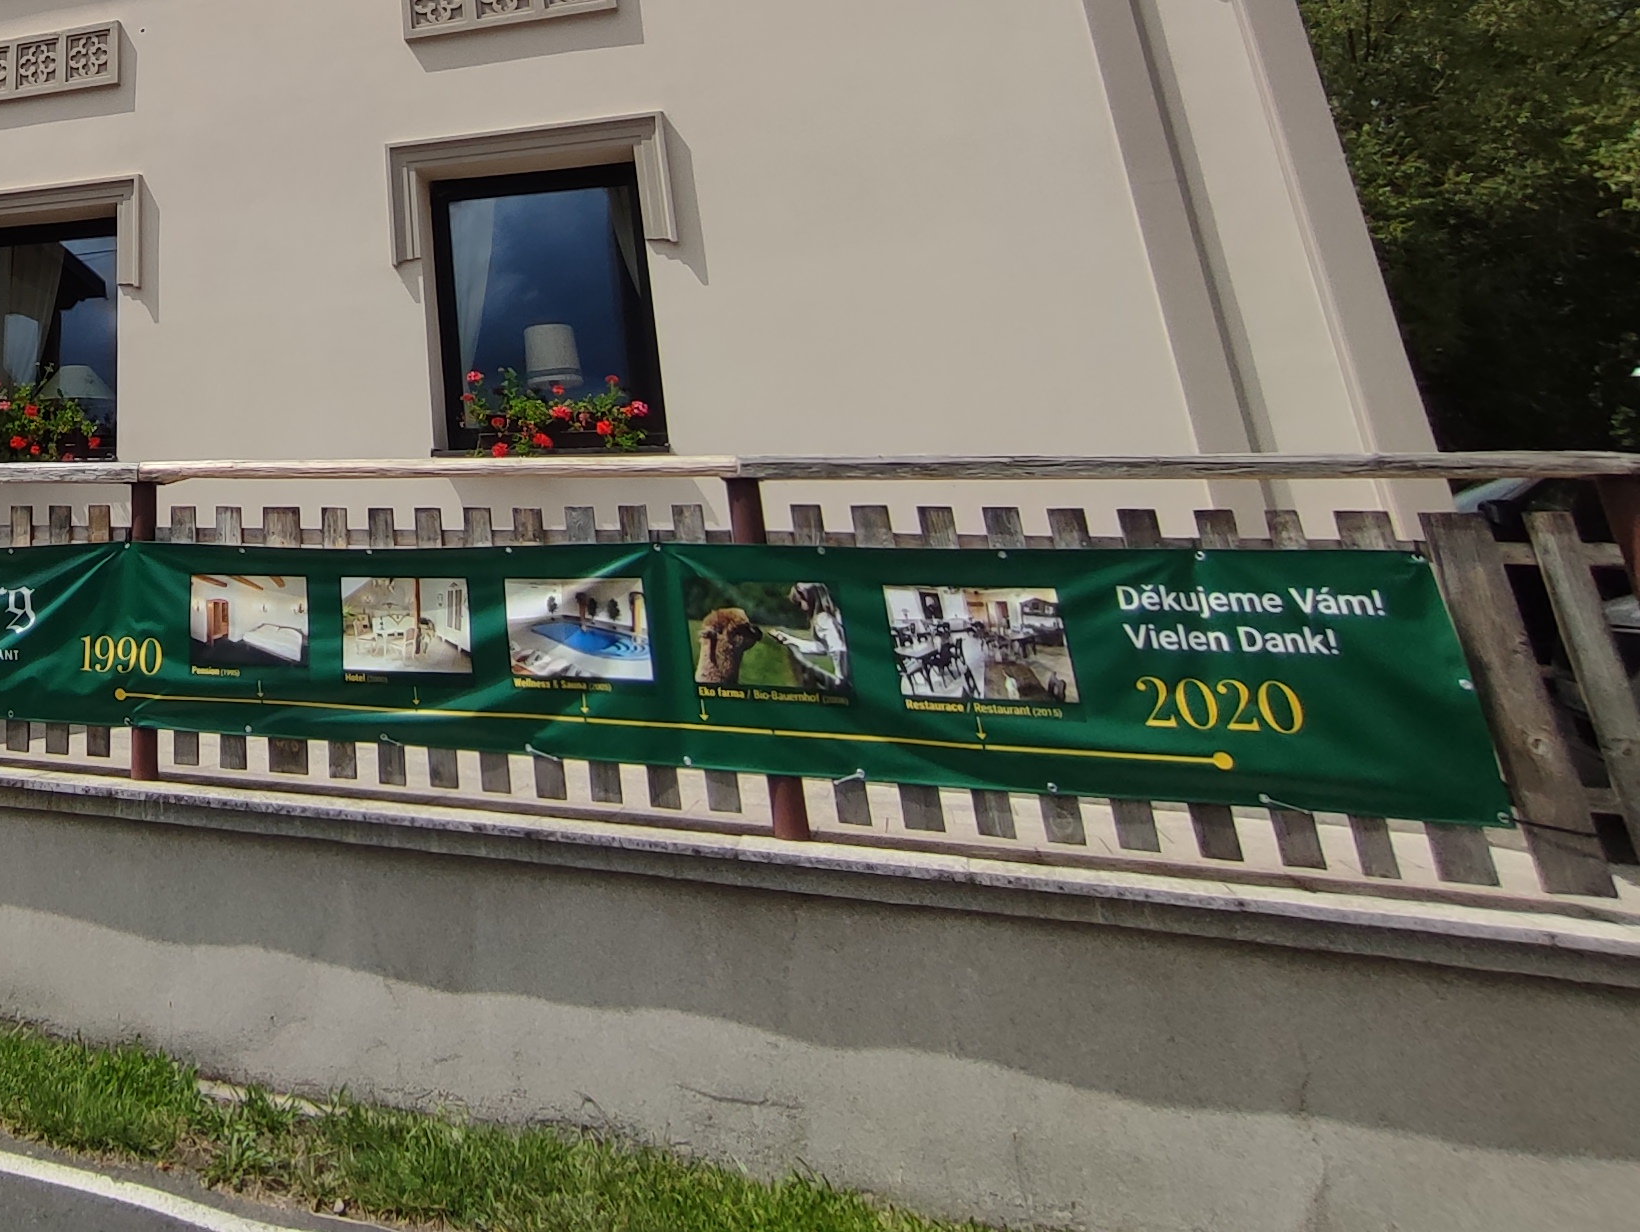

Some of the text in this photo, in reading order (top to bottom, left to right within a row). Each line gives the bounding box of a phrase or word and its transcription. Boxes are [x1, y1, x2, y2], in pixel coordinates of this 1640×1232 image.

[1116, 584, 1387, 618] Děkujeme Vám!
[1122, 623, 1340, 655] Vielen Dank!
[80, 635, 163, 676] 1990
[191, 665, 220, 676] Pension
[345, 672, 366, 682] Hotel
[513, 677, 551, 688] Wellness
[561, 680, 587, 690] Sauna
[698, 686, 716, 696] Eko
[717, 687, 745, 699] farma
[753, 690, 820, 702] Bio-Bauernhof
[905, 699, 964, 712] Restaurace
[973, 703, 1031, 716] Restaurant
[1032, 708, 1063, 719] (2015)
[1135, 676, 1305, 734] 2020
